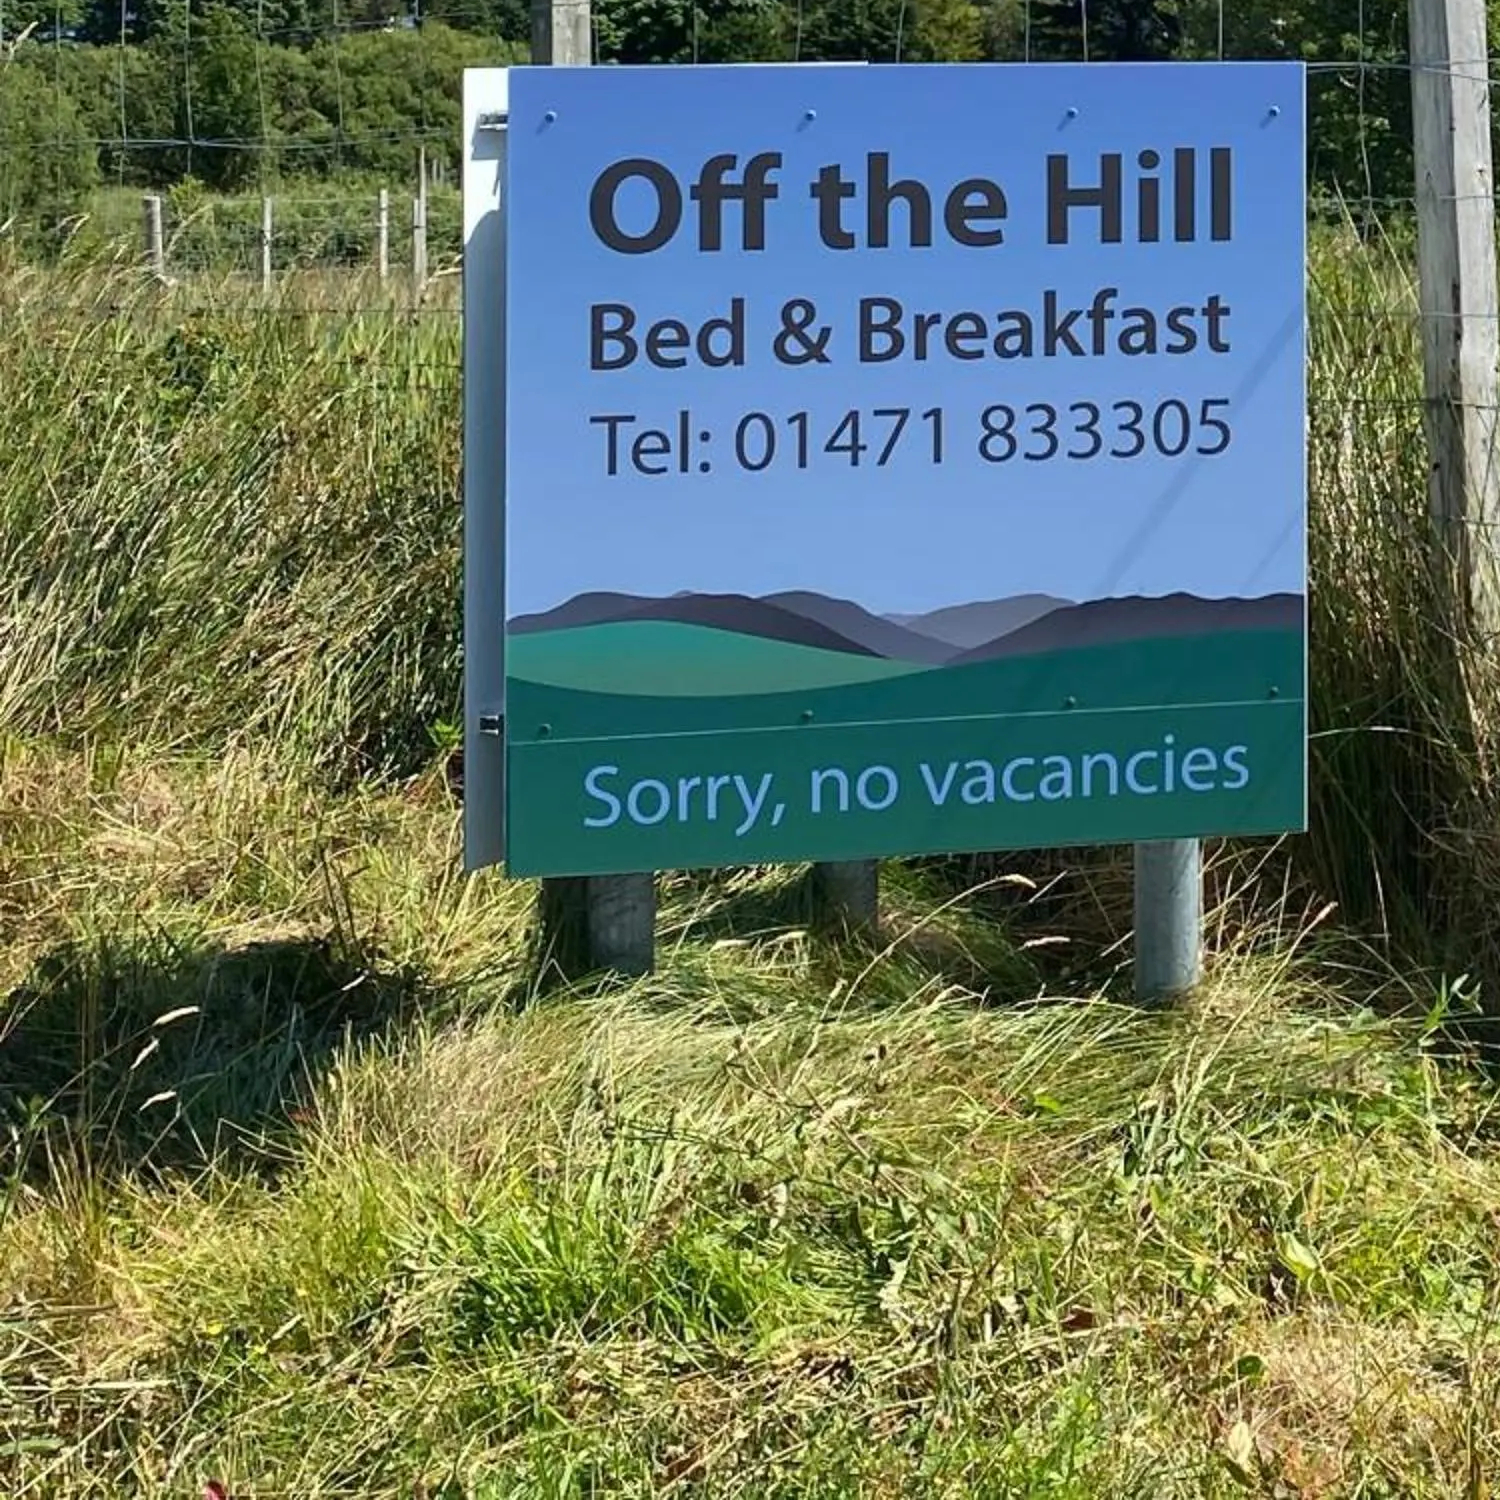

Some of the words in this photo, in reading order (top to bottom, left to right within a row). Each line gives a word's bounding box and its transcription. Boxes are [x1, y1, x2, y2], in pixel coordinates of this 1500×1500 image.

[589, 152, 783, 255] Off
[809, 151, 1008, 251] the
[1046, 147, 1232, 245] Hill
[590, 297, 745, 371] Bed
[772, 298, 832, 366] &
[859, 287, 1231, 363] Breakfast
[589, 410, 711, 476] Tel:
[735, 407, 943, 471] 01471
[978, 398, 1231, 463] 833305
[584, 765, 785, 837] Sorry,
[811, 765, 899, 813] no
[919, 734, 1249, 805] vacancies
